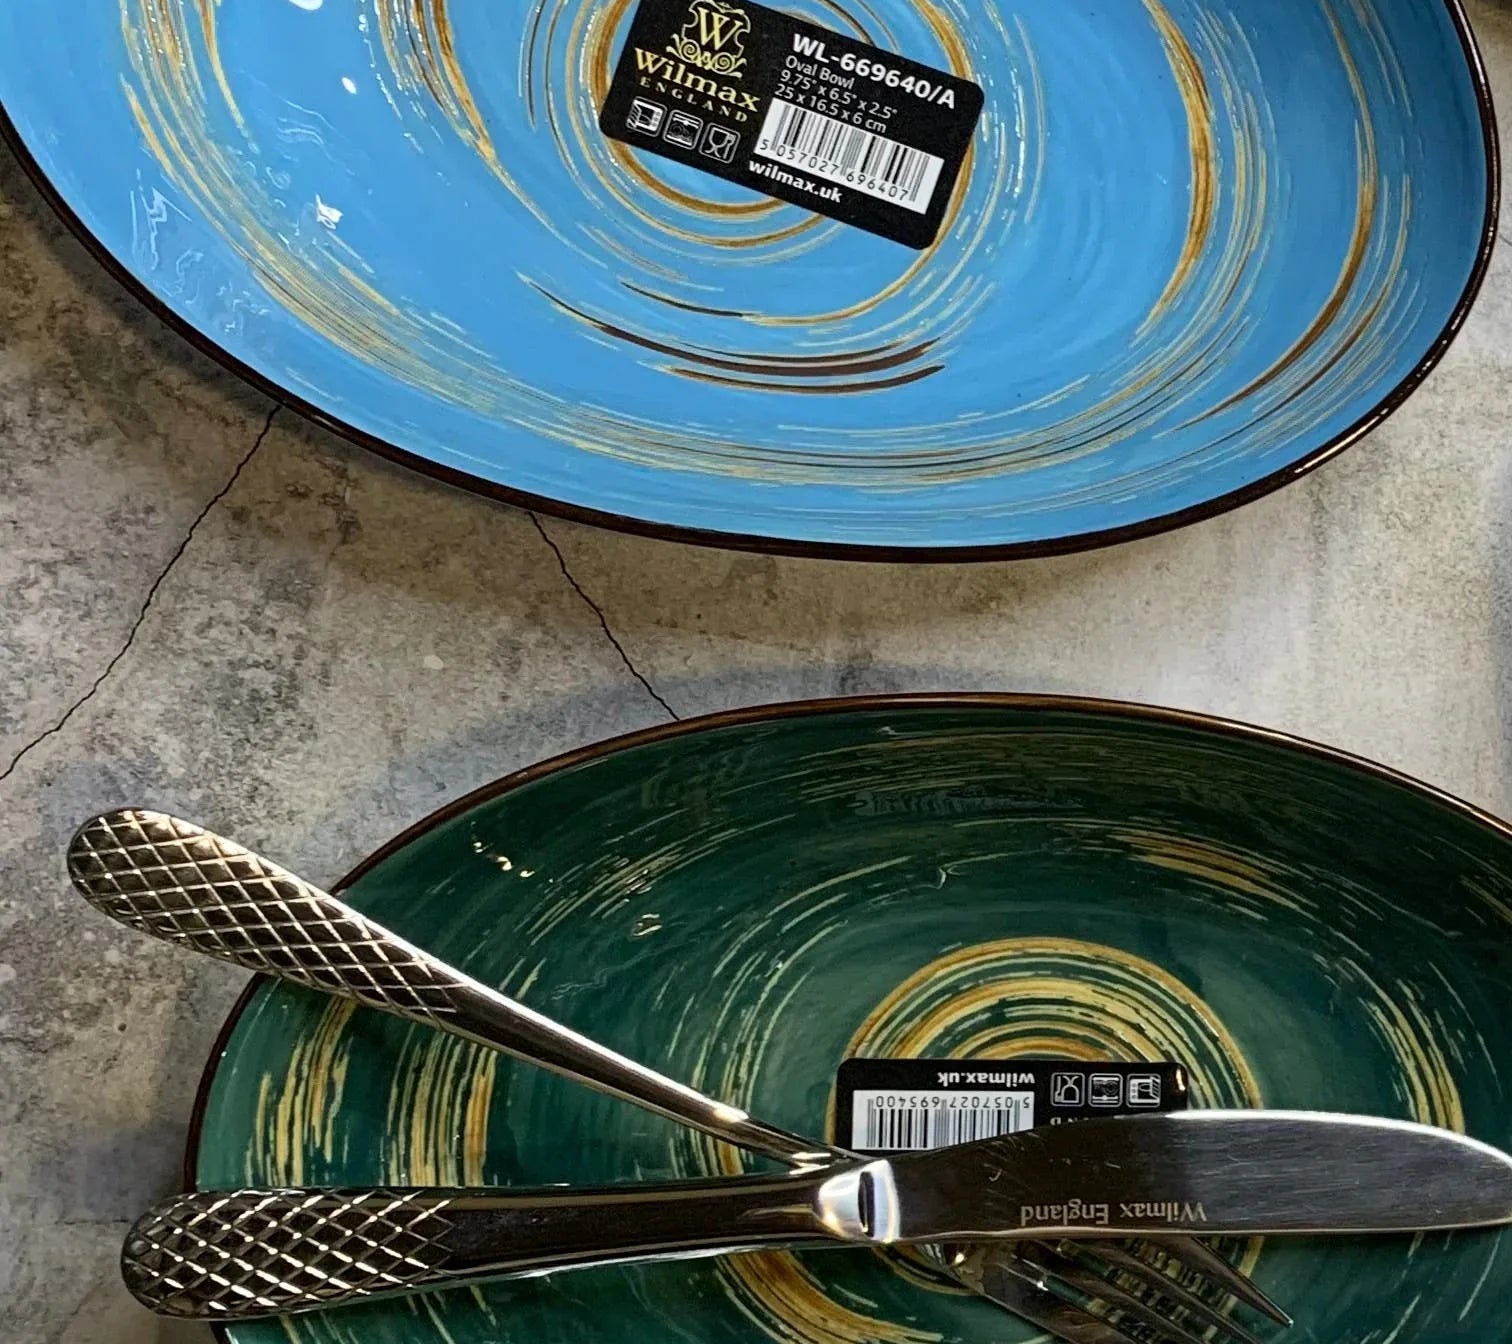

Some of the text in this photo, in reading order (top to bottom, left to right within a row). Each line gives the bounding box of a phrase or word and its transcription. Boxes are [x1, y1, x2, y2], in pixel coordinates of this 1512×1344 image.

[634, 47, 760, 112] Wilmax
[785, 55, 855, 89] Oval Bowl
[793, 33, 954, 109] WL-669640/A
[640, 76, 747, 121] ENGLAND
[774, 83, 886, 133] 25 x 16.5 x 6 cm
[817, 85, 826, 96] x
[857, 100, 867, 110] x
[749, 160, 842, 202] wilmax.uk
[759, 138, 908, 200] 5 057027 696407
[936, 1070, 1034, 1086] wilmax.uk
[875, 1094, 1030, 1108] 5 057027 695400
[1020, 1198, 1206, 1225] Wilmax England
